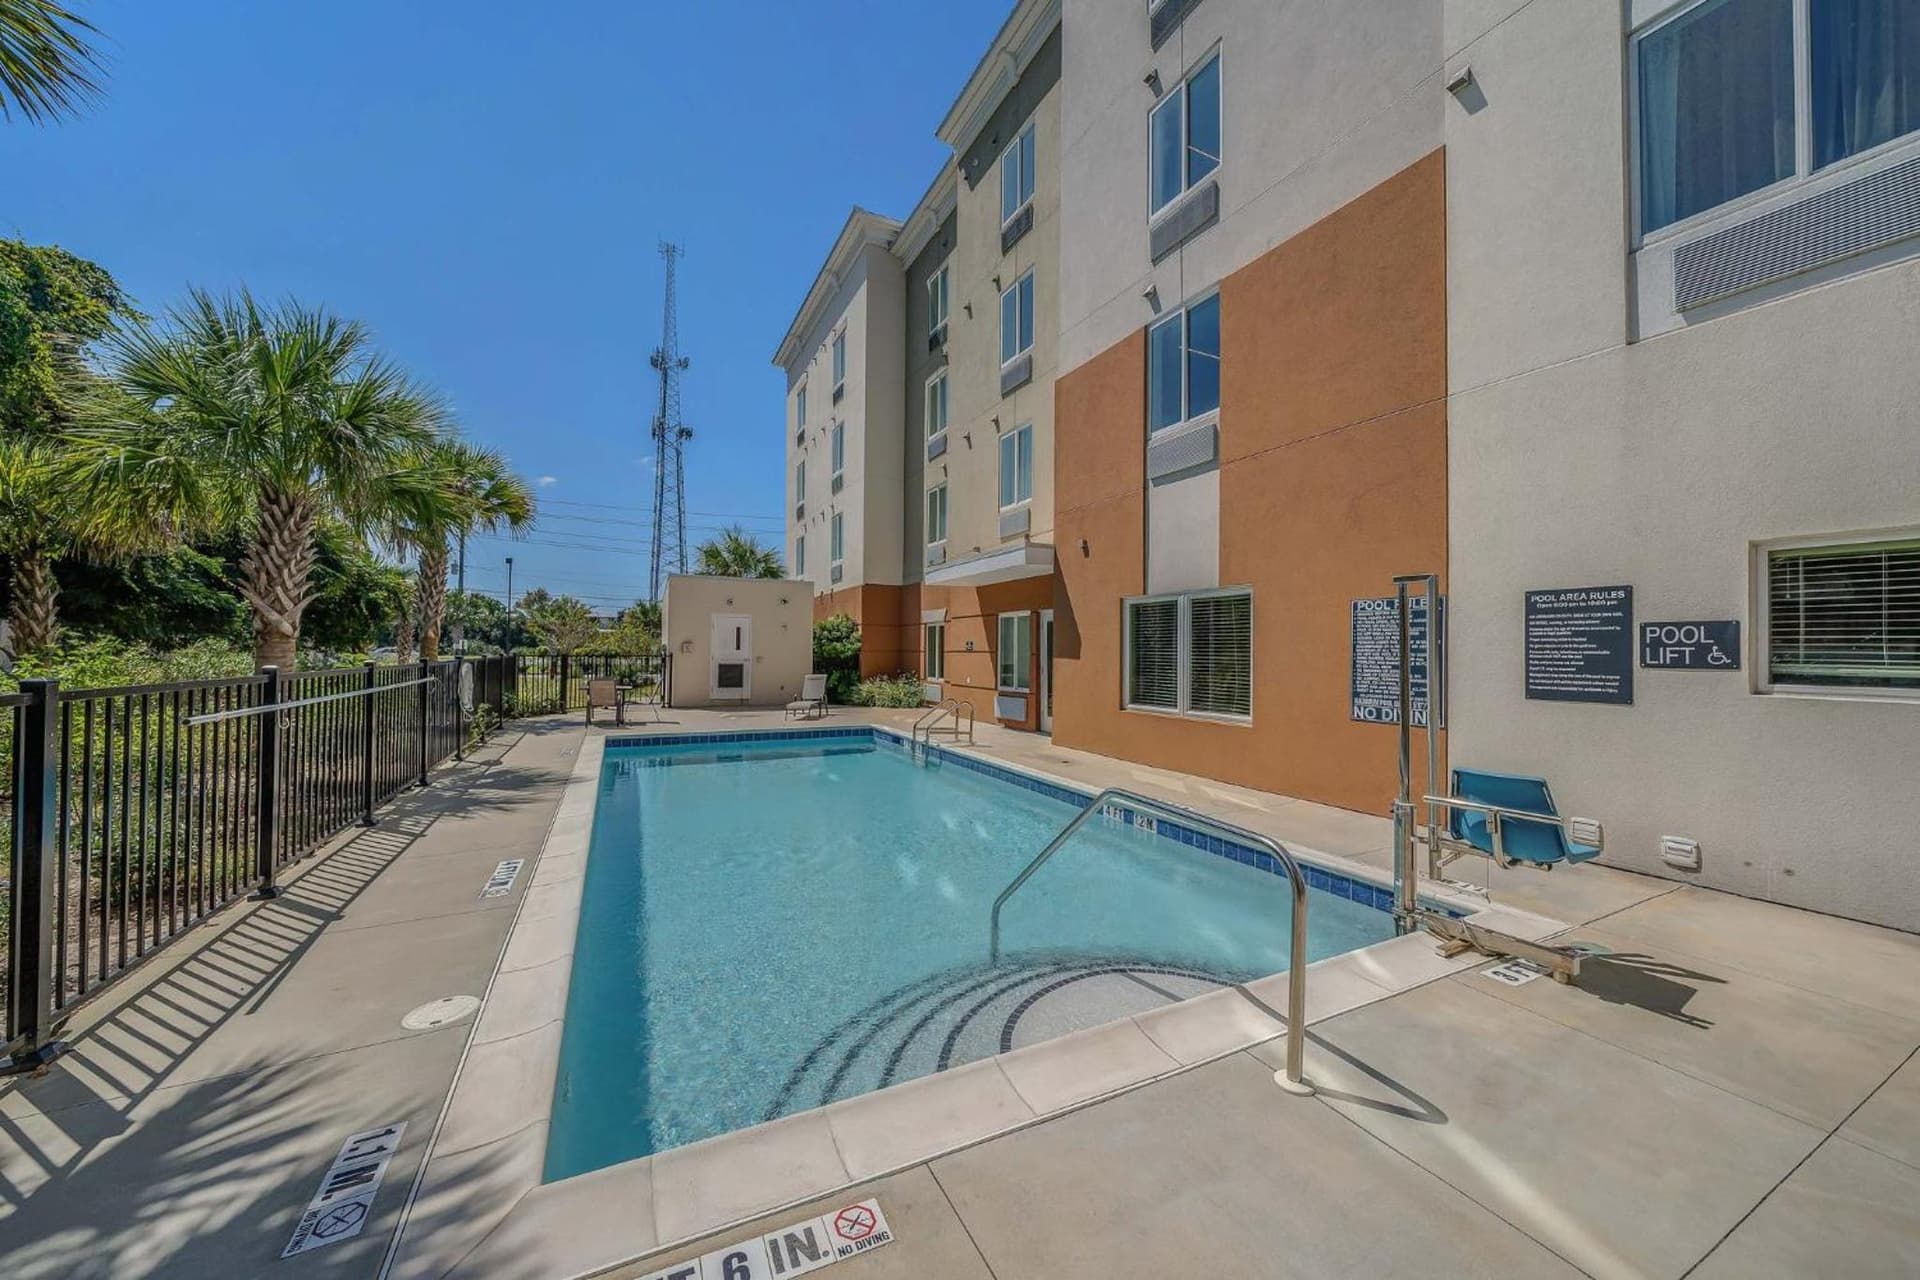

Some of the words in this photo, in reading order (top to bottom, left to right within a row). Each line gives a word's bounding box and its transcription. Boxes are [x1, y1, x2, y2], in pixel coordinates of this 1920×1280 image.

[1357, 599, 1391, 611] POOL
[1531, 594, 1557, 602] POOL
[1559, 592, 1587, 601] AREA
[1590, 590, 1625, 600] RULES
[1646, 625, 1714, 644] POOL
[1646, 647, 1695, 665] LIFT
[1354, 706, 1377, 719] NO
[342, 1128, 396, 1162] 1.1
[321, 1163, 380, 1202] M.
[722, 1251, 750, 1280] 6
[768, 1227, 830, 1275] IN.
[837, 1245, 853, 1259] NO
[855, 1231, 890, 1252] DIVING
